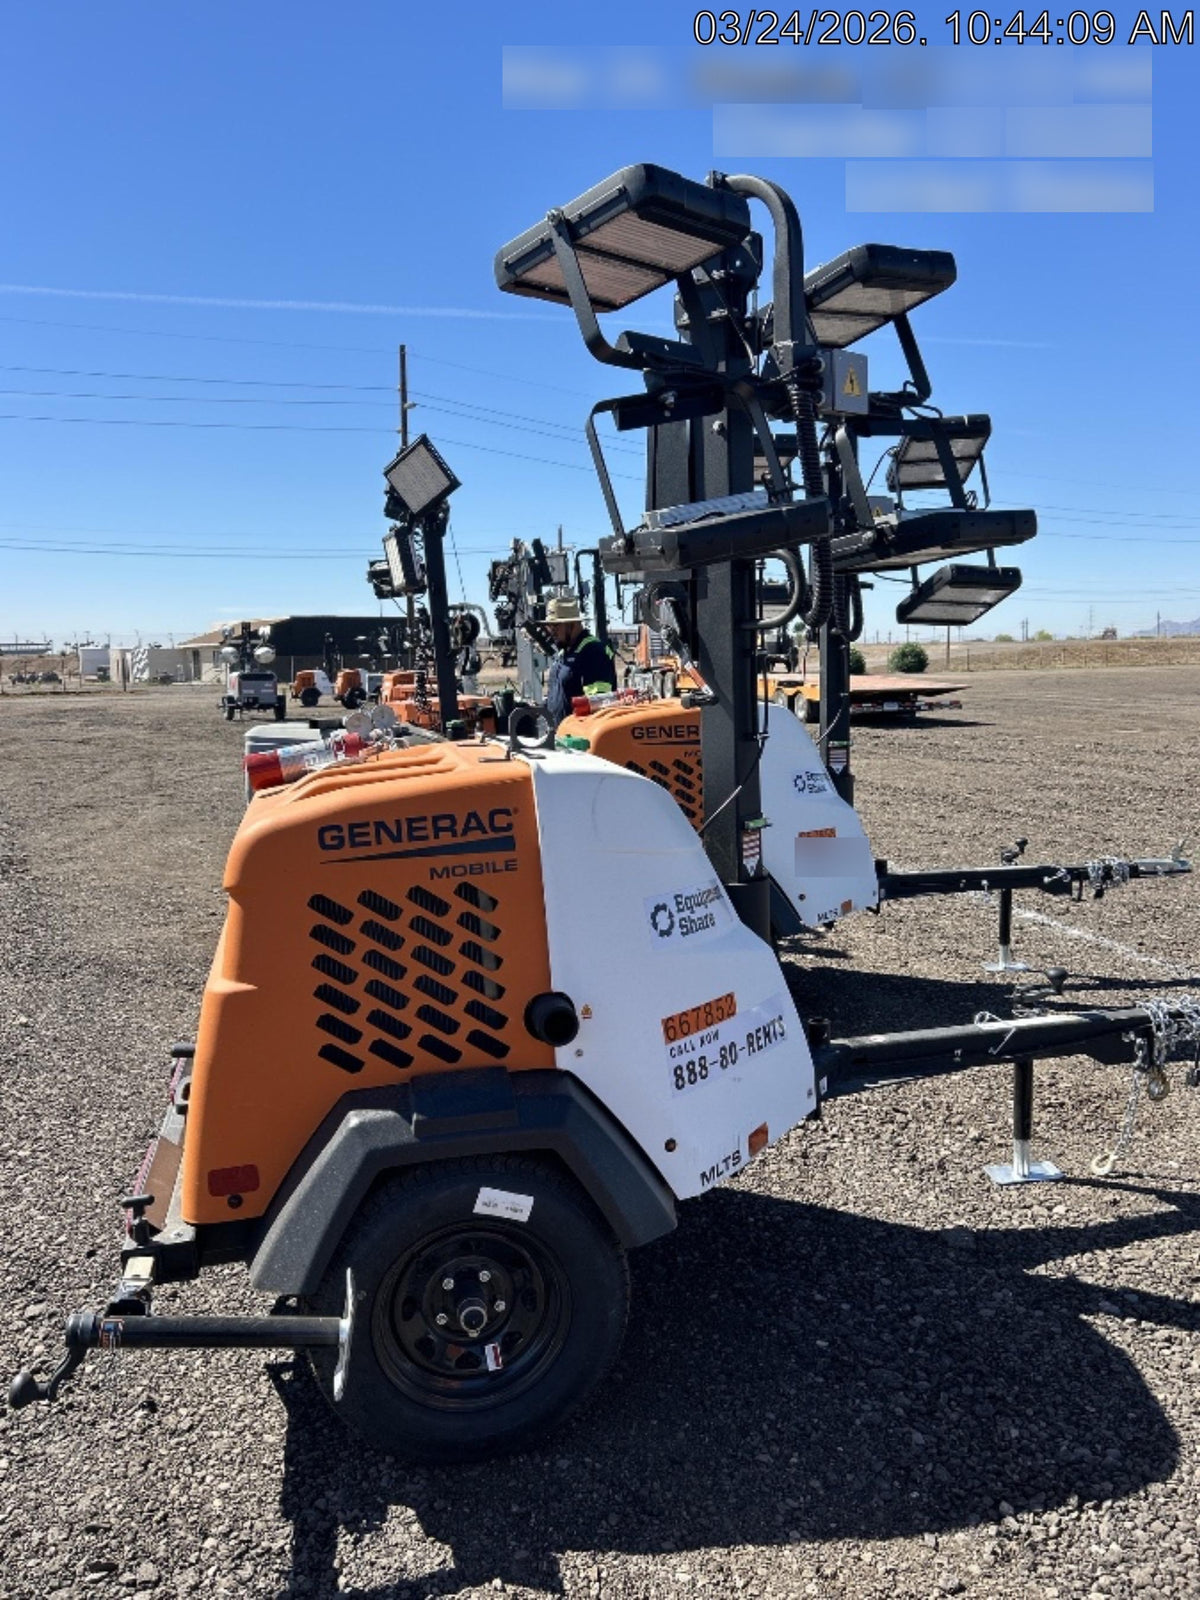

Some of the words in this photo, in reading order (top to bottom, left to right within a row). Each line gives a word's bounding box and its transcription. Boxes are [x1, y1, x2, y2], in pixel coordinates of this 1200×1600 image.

[631, 724, 701, 740] GENER
[317, 808, 514, 851] GENERAC
[429, 858, 518, 880] MOBILE
[678, 912, 715, 938] Share
[663, 993, 735, 1042] 667852
[669, 1039, 696, 1059] CALL
[673, 1014, 785, 1091] 888-80-RENTS
[700, 1149, 742, 1187] MLTS
